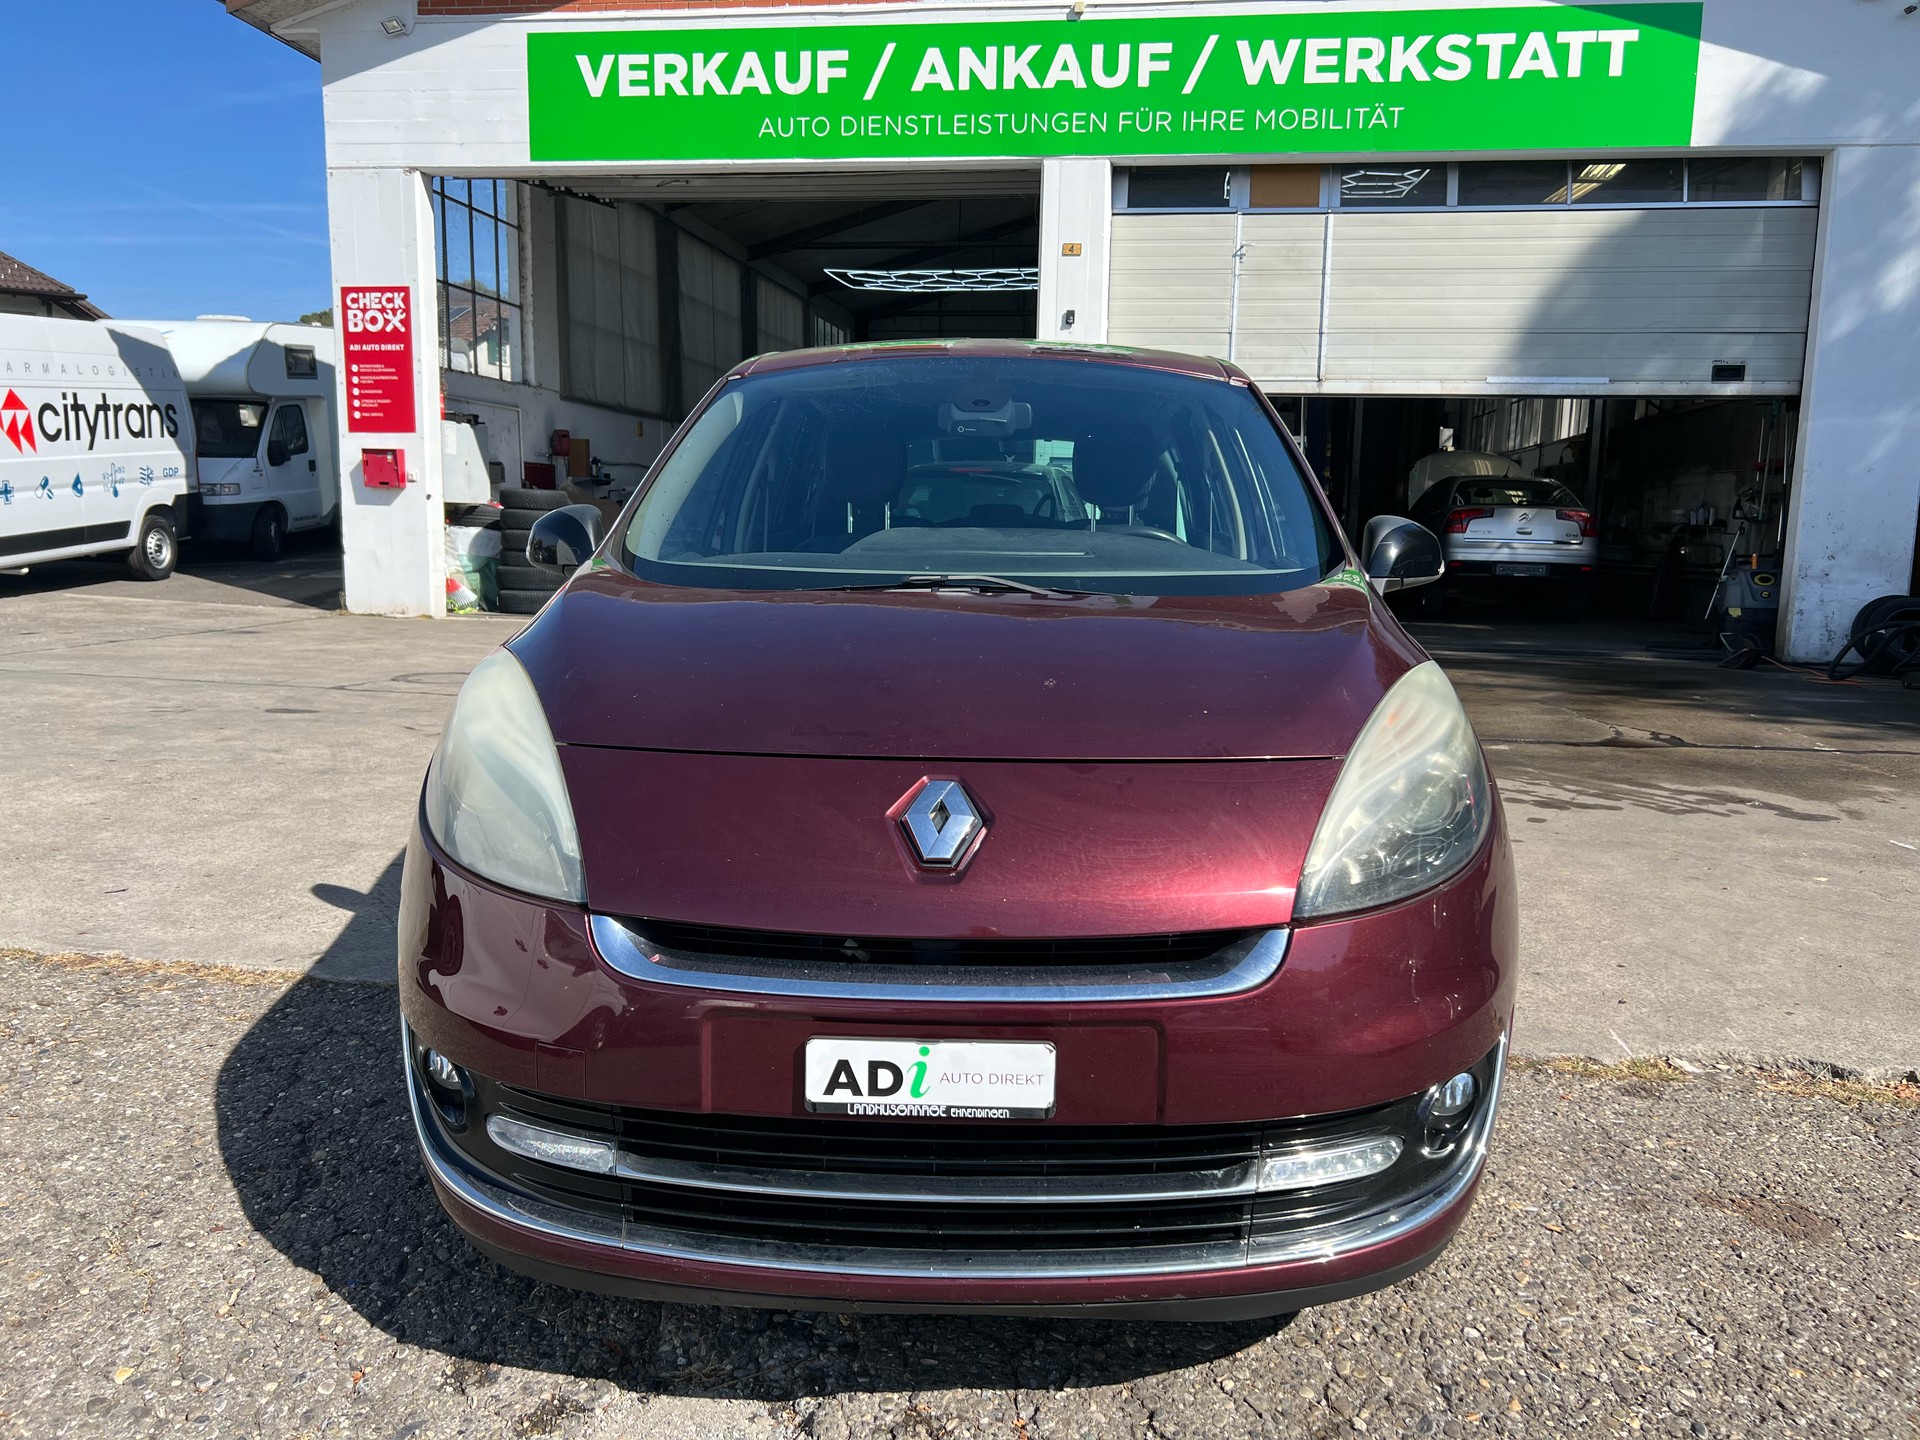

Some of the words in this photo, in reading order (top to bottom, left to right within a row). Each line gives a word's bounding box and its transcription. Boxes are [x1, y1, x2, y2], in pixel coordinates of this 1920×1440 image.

[574, 49, 850, 98] VERKAUF
[863, 43, 897, 101] /
[911, 43, 1173, 92] ANKAUF
[1182, 35, 1220, 95] /
[1236, 29, 1640, 86] WERKSTATT
[758, 116, 831, 138] AUTO
[840, 112, 1107, 137] DIENSTLEISTUNGEN
[1118, 107, 1172, 133] FÜR
[1182, 110, 1245, 132] IHRE
[1255, 103, 1405, 131] MOBILITÄT
[346, 291, 406, 309] CHECK
[347, 308, 406, 333] BOX
[349, 343, 362, 352] ADI
[362, 343, 380, 352] AUTO
[381, 343, 405, 352] DIREKT
[38, 391, 179, 451] citytrans
[162, 467, 179, 478] GDP
[940, 1072, 983, 1085] AUTO
[988, 1072, 1045, 1086] DIREKT
